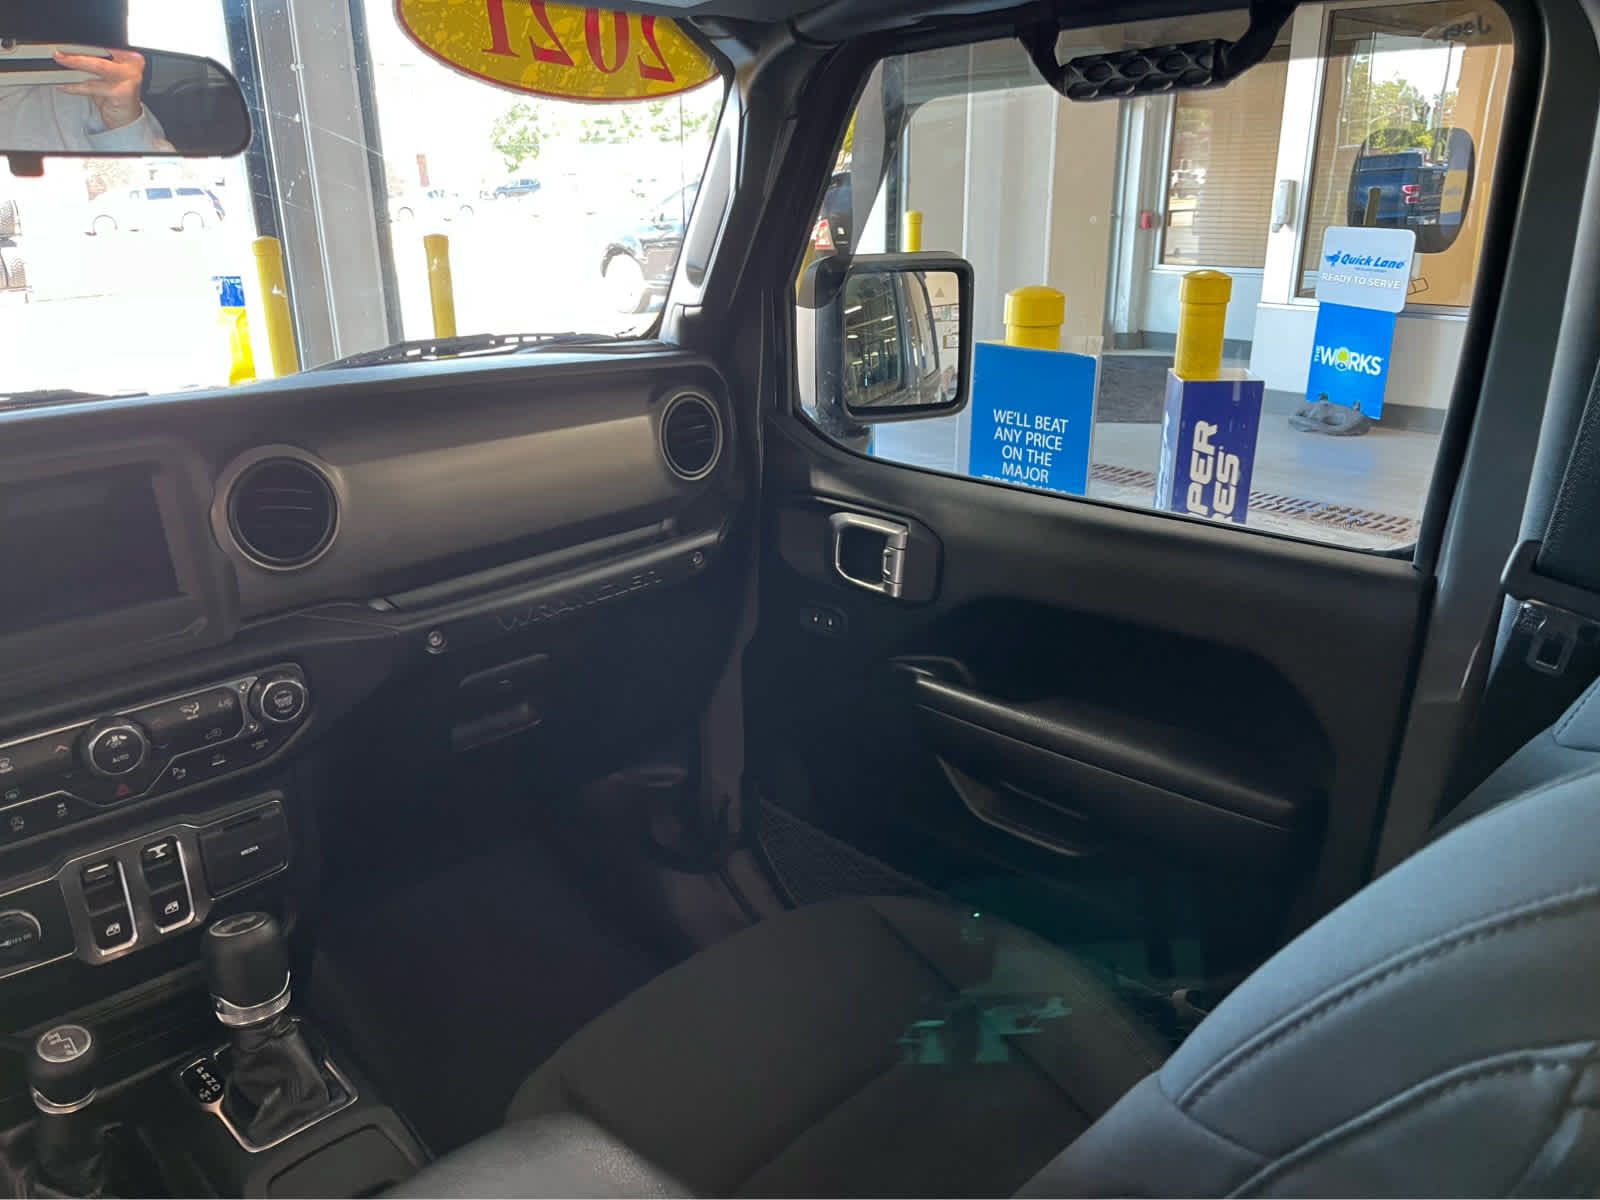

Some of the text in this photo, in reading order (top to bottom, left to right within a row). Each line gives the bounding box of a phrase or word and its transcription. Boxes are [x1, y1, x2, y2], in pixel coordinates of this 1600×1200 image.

[1340, 253, 1405, 269] Quick Lane
[1321, 272, 1401, 289] READY TO SERVE
[1319, 345, 1382, 376] WORKS
[993, 408, 1069, 434] WE'LL BEAT
[993, 427, 1063, 451] ANY PRICE
[1001, 444, 1052, 467] ON THE
[1001, 461, 1049, 484] MAJOR
[1186, 420, 1218, 519] PER
[1212, 451, 1240, 522] ES
